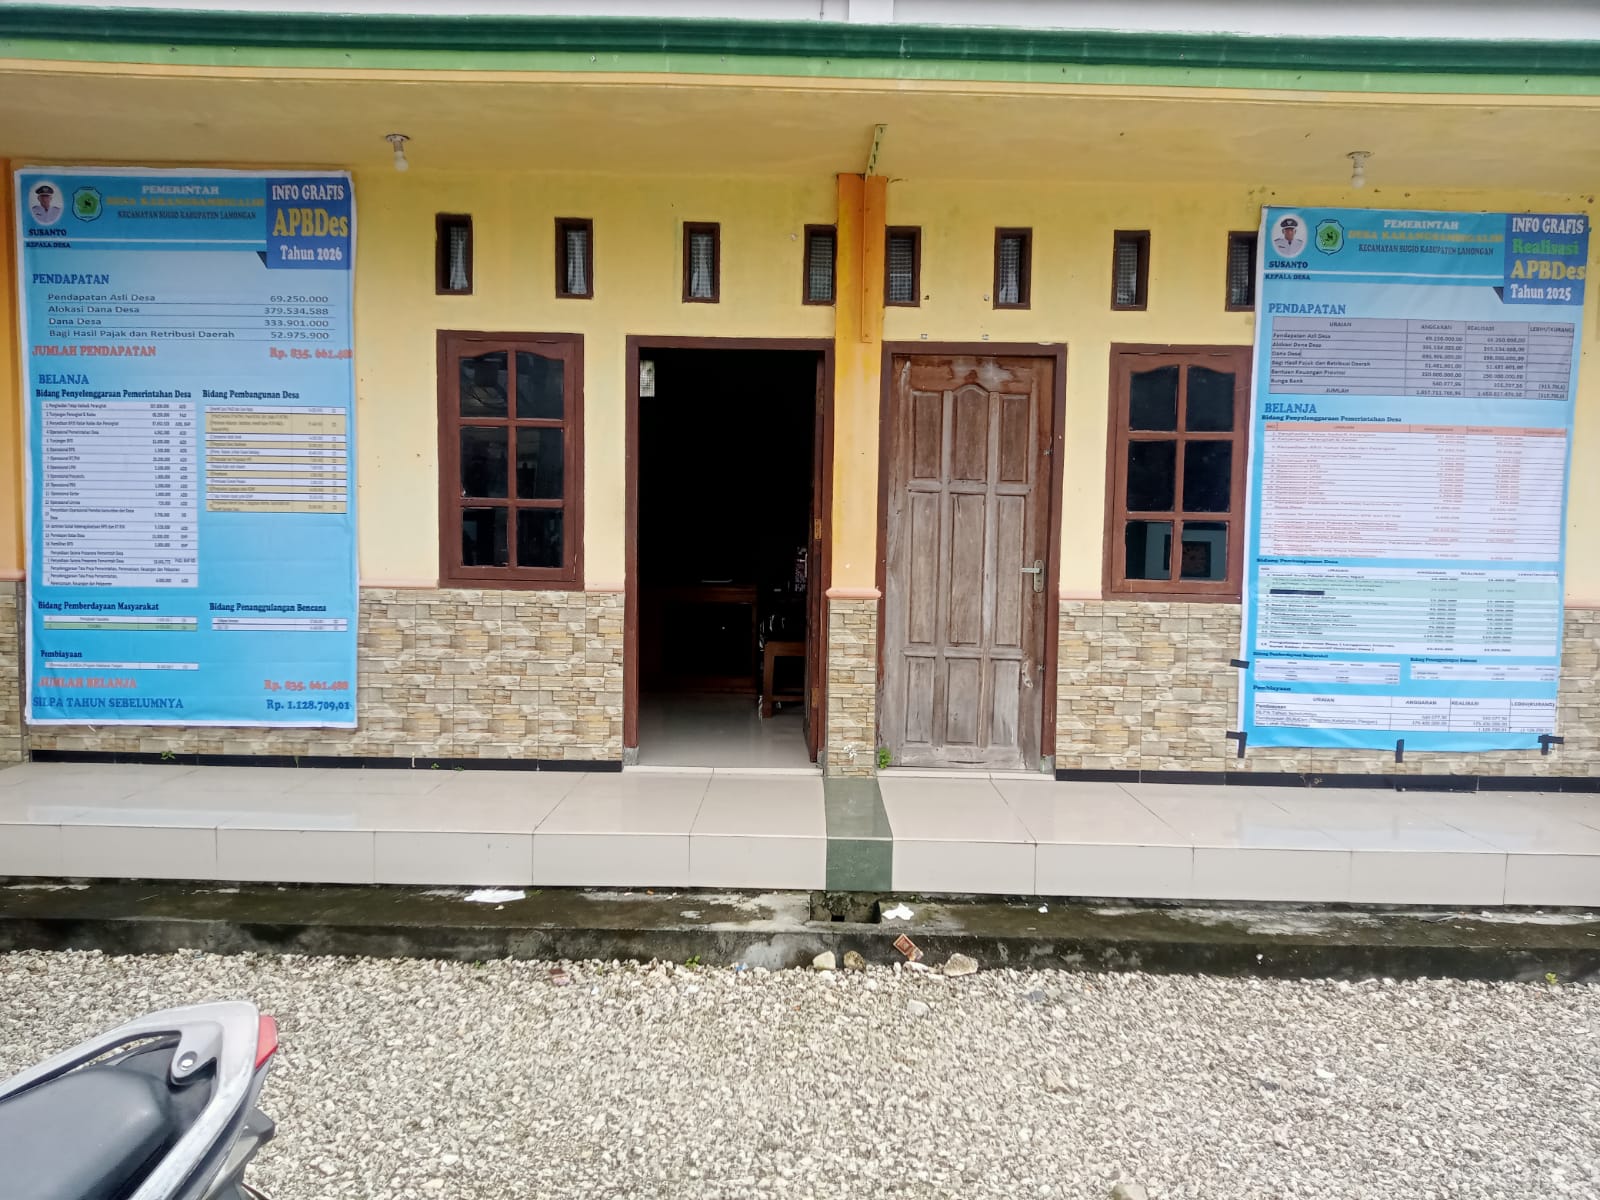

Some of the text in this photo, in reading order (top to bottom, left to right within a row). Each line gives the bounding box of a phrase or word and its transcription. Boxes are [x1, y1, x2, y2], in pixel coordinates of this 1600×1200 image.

[142, 185, 219, 195] PEMERINTAH
[272, 185, 344, 200] INFO GRAFIS
[272, 208, 348, 236] APBDes
[1384, 220, 1458, 230] PEMERINTAH
[1512, 218, 1584, 234] INFO GRAFIS
[280, 245, 342, 260] Tahun 2026
[1359, 244, 1398, 252] KECAMATAN
[1421, 246, 1456, 254] KABUPATEN
[1458, 248, 1494, 256] LAMONGAN
[1512, 239, 1579, 255] Realisasi
[1510, 260, 1585, 280] APBDes
[33, 274, 110, 284] PENDAPATAN
[1511, 284, 1571, 300] Tahun 2025
[48, 294, 106, 302] Pendapatan
[1268, 303, 1346, 314] PENDAPATAN
[50, 330, 70, 338] Bagi
[100, 330, 126, 338] Pajak
[32, 345, 156, 356] JUMLAH PENDAPATAN
[269, 347, 288, 360] Rp.
[38, 374, 90, 384] BELANJA
[36, 389, 192, 399] Bidang Penyelenggaraan Pemerintahan Desa
[202, 390, 228, 399] Bidang
[230, 390, 280, 400] Pembangunan
[1264, 402, 1317, 414] BELANJA
[38, 601, 159, 611] Bidang Pemberdayaan Masyarakat
[210, 603, 234, 612] Bidang
[236, 603, 296, 612] Penanggulangan
[40, 650, 82, 658] Pembiayaan
[38, 677, 137, 688] JUMLAH BELANJA
[264, 680, 282, 692] Rp.
[32, 697, 184, 708] SILPA TAHUN SEBELUMNYA
[266, 699, 350, 712] Rp. 1.128.709,01
